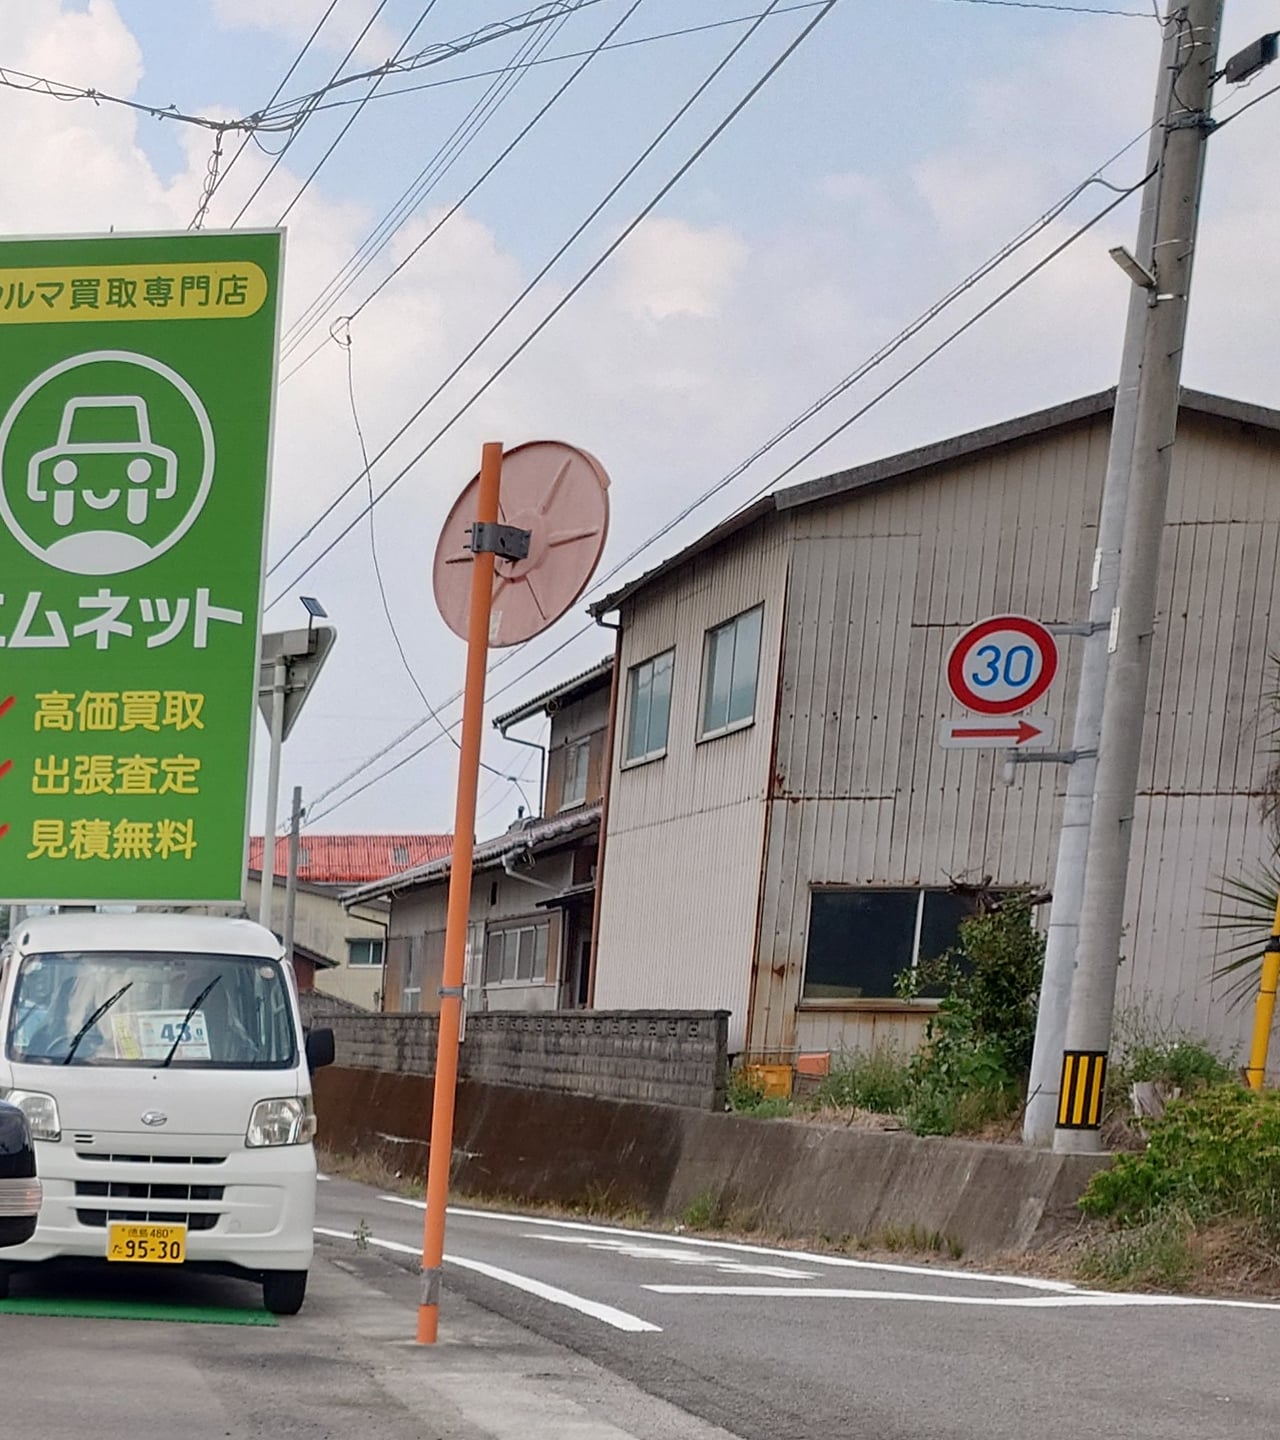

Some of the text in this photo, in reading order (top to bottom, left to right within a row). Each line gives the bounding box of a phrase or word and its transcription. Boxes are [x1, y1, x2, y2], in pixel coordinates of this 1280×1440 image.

[971, 644, 1035, 688] 30
[33, 690, 206, 732] 高価買取
[30, 754, 202, 796] 出張査定
[26, 819, 197, 860] 見積無料
[125, 1240, 181, 1260] 95-30
